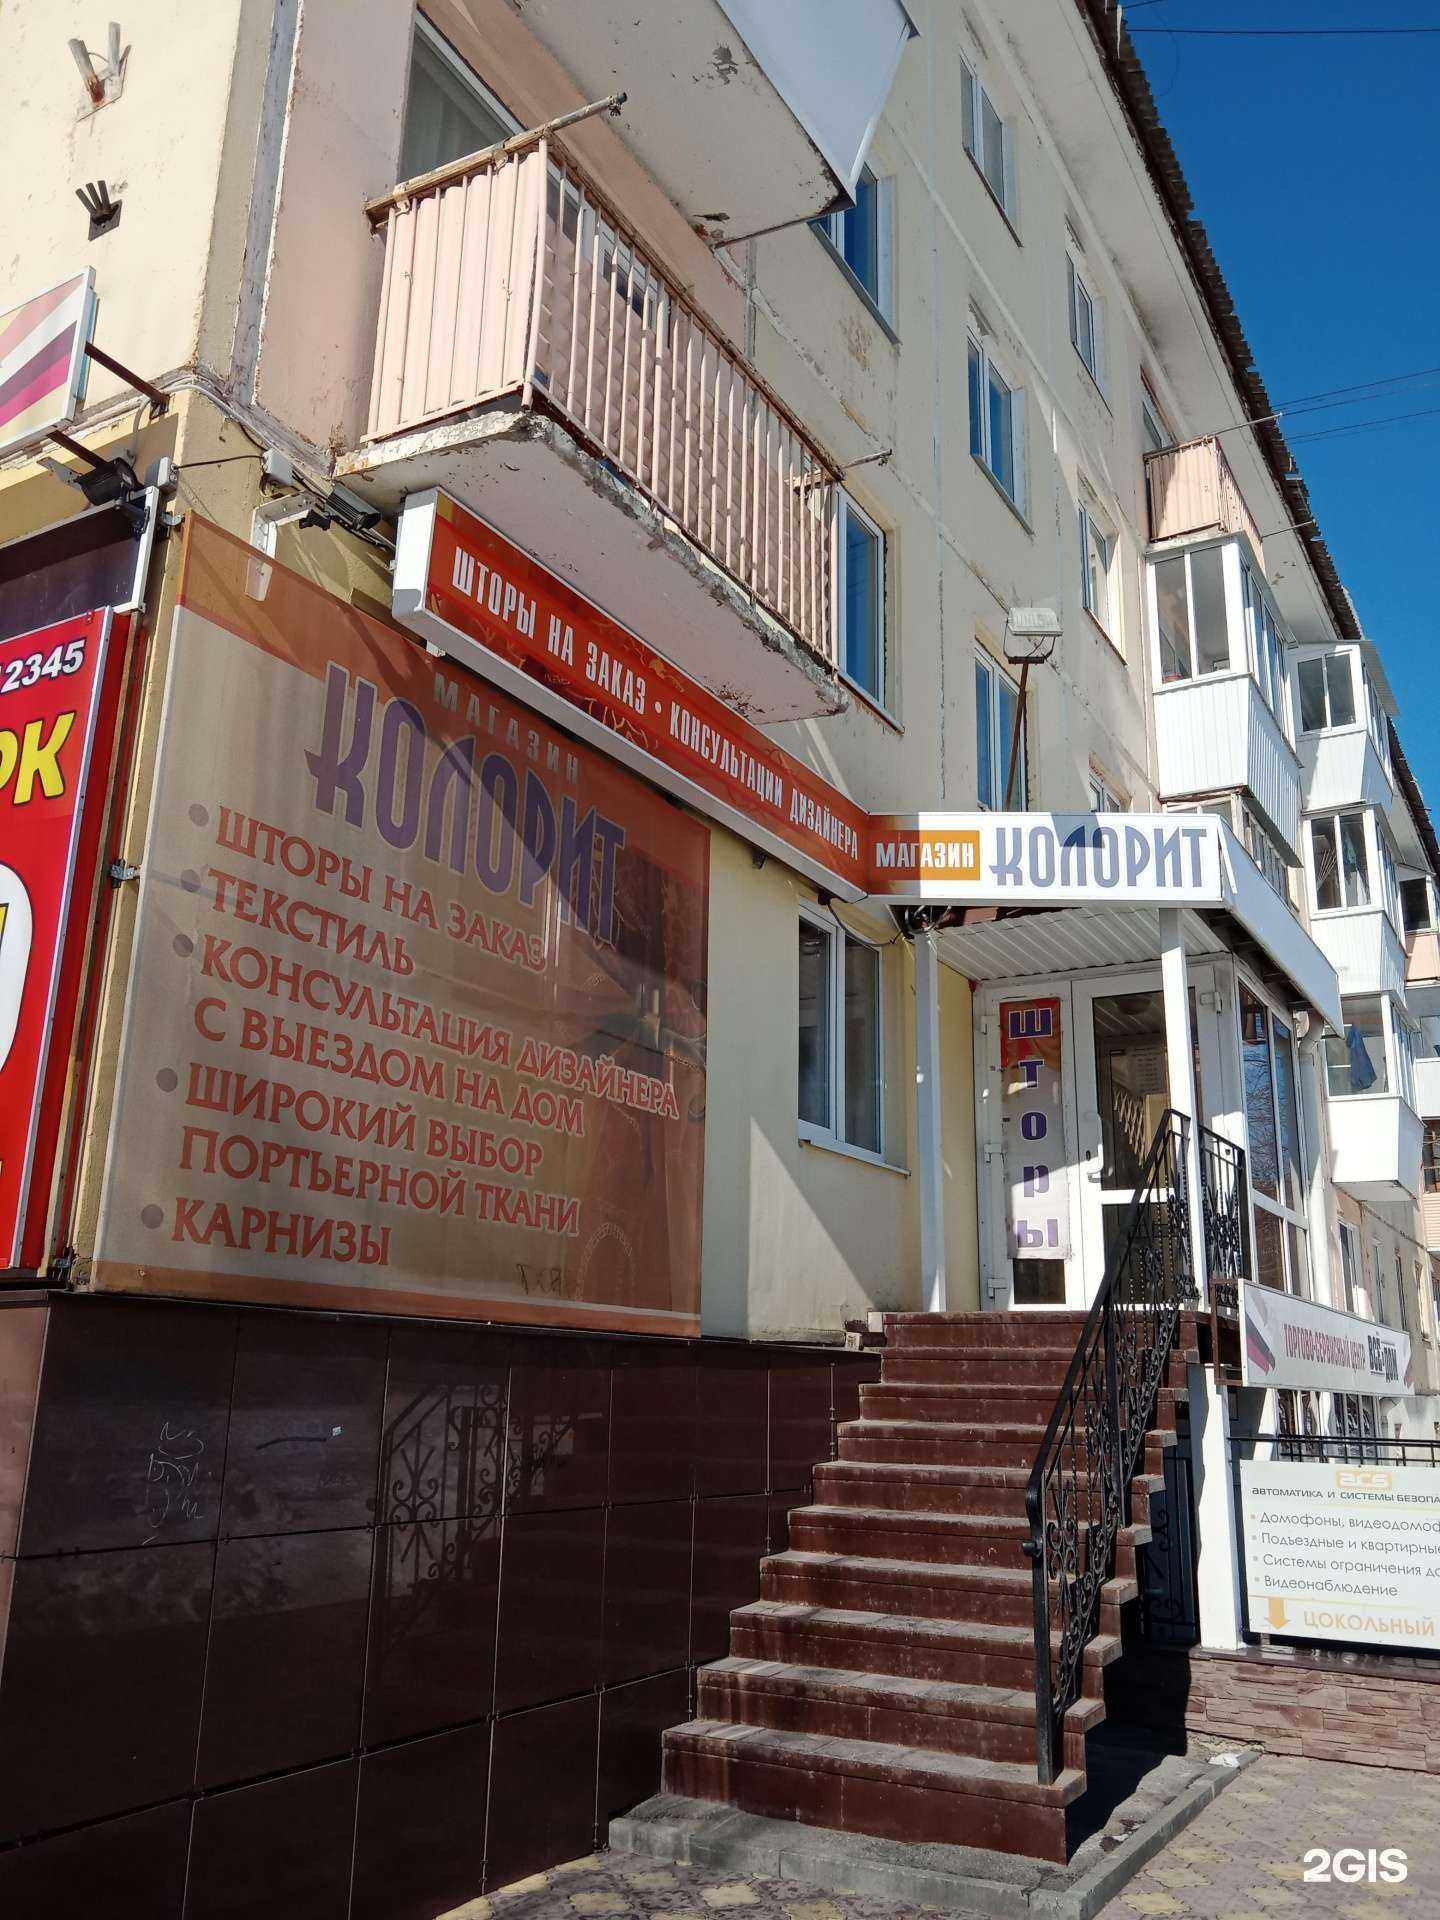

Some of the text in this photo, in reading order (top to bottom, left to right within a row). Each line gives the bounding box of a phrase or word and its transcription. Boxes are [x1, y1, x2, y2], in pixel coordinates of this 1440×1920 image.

[0, 640, 85, 693] 2345
[452, 546, 858, 860] ШТОРЫ НА ЗАКАЗ КОНСУЛЬТАЦИИ ДИЗАЙНЕРА
[434, 672, 580, 785] МАГАЗИН
[304, 660, 625, 945] КОЛОРИТ
[216, 806, 546, 972] ШТОРЫ НА ЗАКАЗ
[875, 825, 1207, 888] МАГАЗИН КОЛОРИТ
[208, 868, 414, 975] ТЕКСТИЛЬ
[194, 997, 584, 1135] С ВЫЕЗДОМ НА ДОМ
[201, 934, 679, 1119] КОНСУЛЬТАЦИЯ ДИЗАЙНЕРА
[186, 1063, 543, 1176] ШИРОКИЙ ВЫБОР
[172, 1197, 392, 1266] КАРНИЗЫ
[179, 1126, 580, 1235] ПОРТЬЕРНОЙ ТКАНИ
[1260, 1512, 1345, 1528] Домофоны,
[1261, 1532, 1344, 1549] Подъездные
[1349, 1540, 1357, 1549] и
[1263, 1553, 1327, 1569] Системы
[1330, 1560, 1422, 1577] ограничения
[1265, 1576, 1398, 1596] Видеонаблюдение
[1304, 1611, 1435, 1636] ЦОКОЛЬНЫЙ
